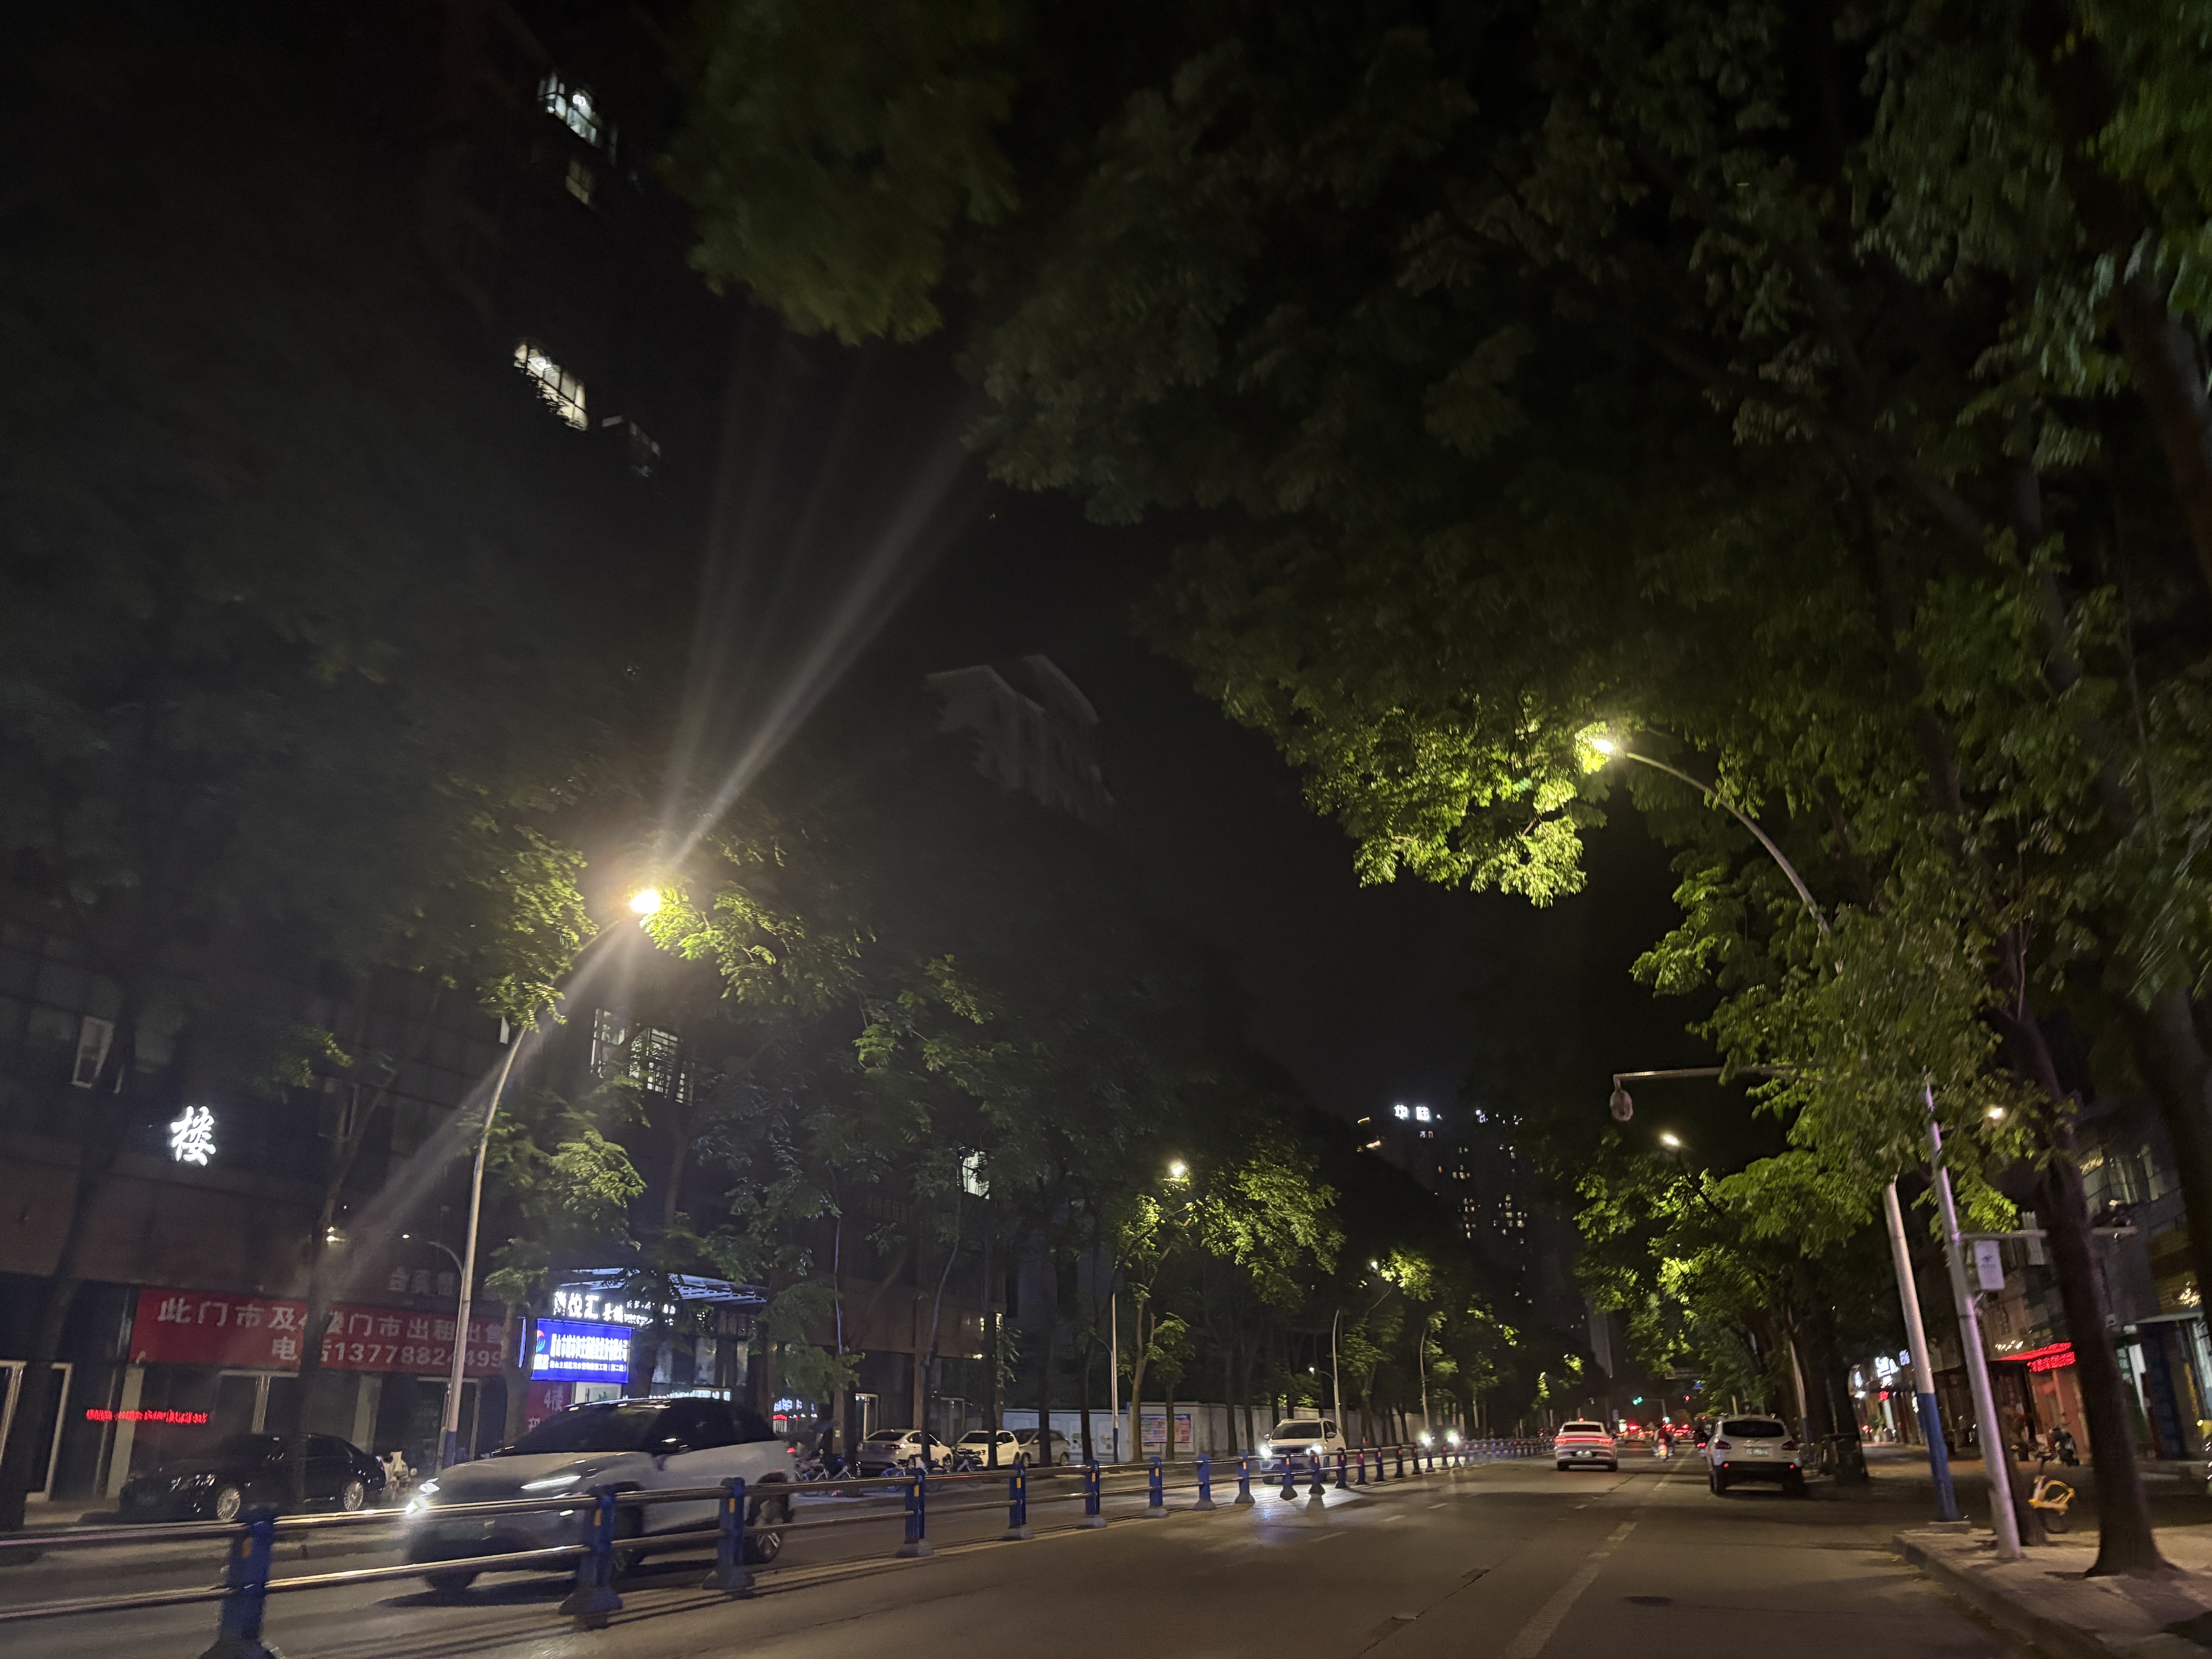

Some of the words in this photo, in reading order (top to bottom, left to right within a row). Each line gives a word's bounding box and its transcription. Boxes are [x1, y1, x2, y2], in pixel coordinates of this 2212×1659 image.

[171, 1106, 216, 1166] 楼
[157, 1297, 502, 1343] 此门市及楼门市出租出售
